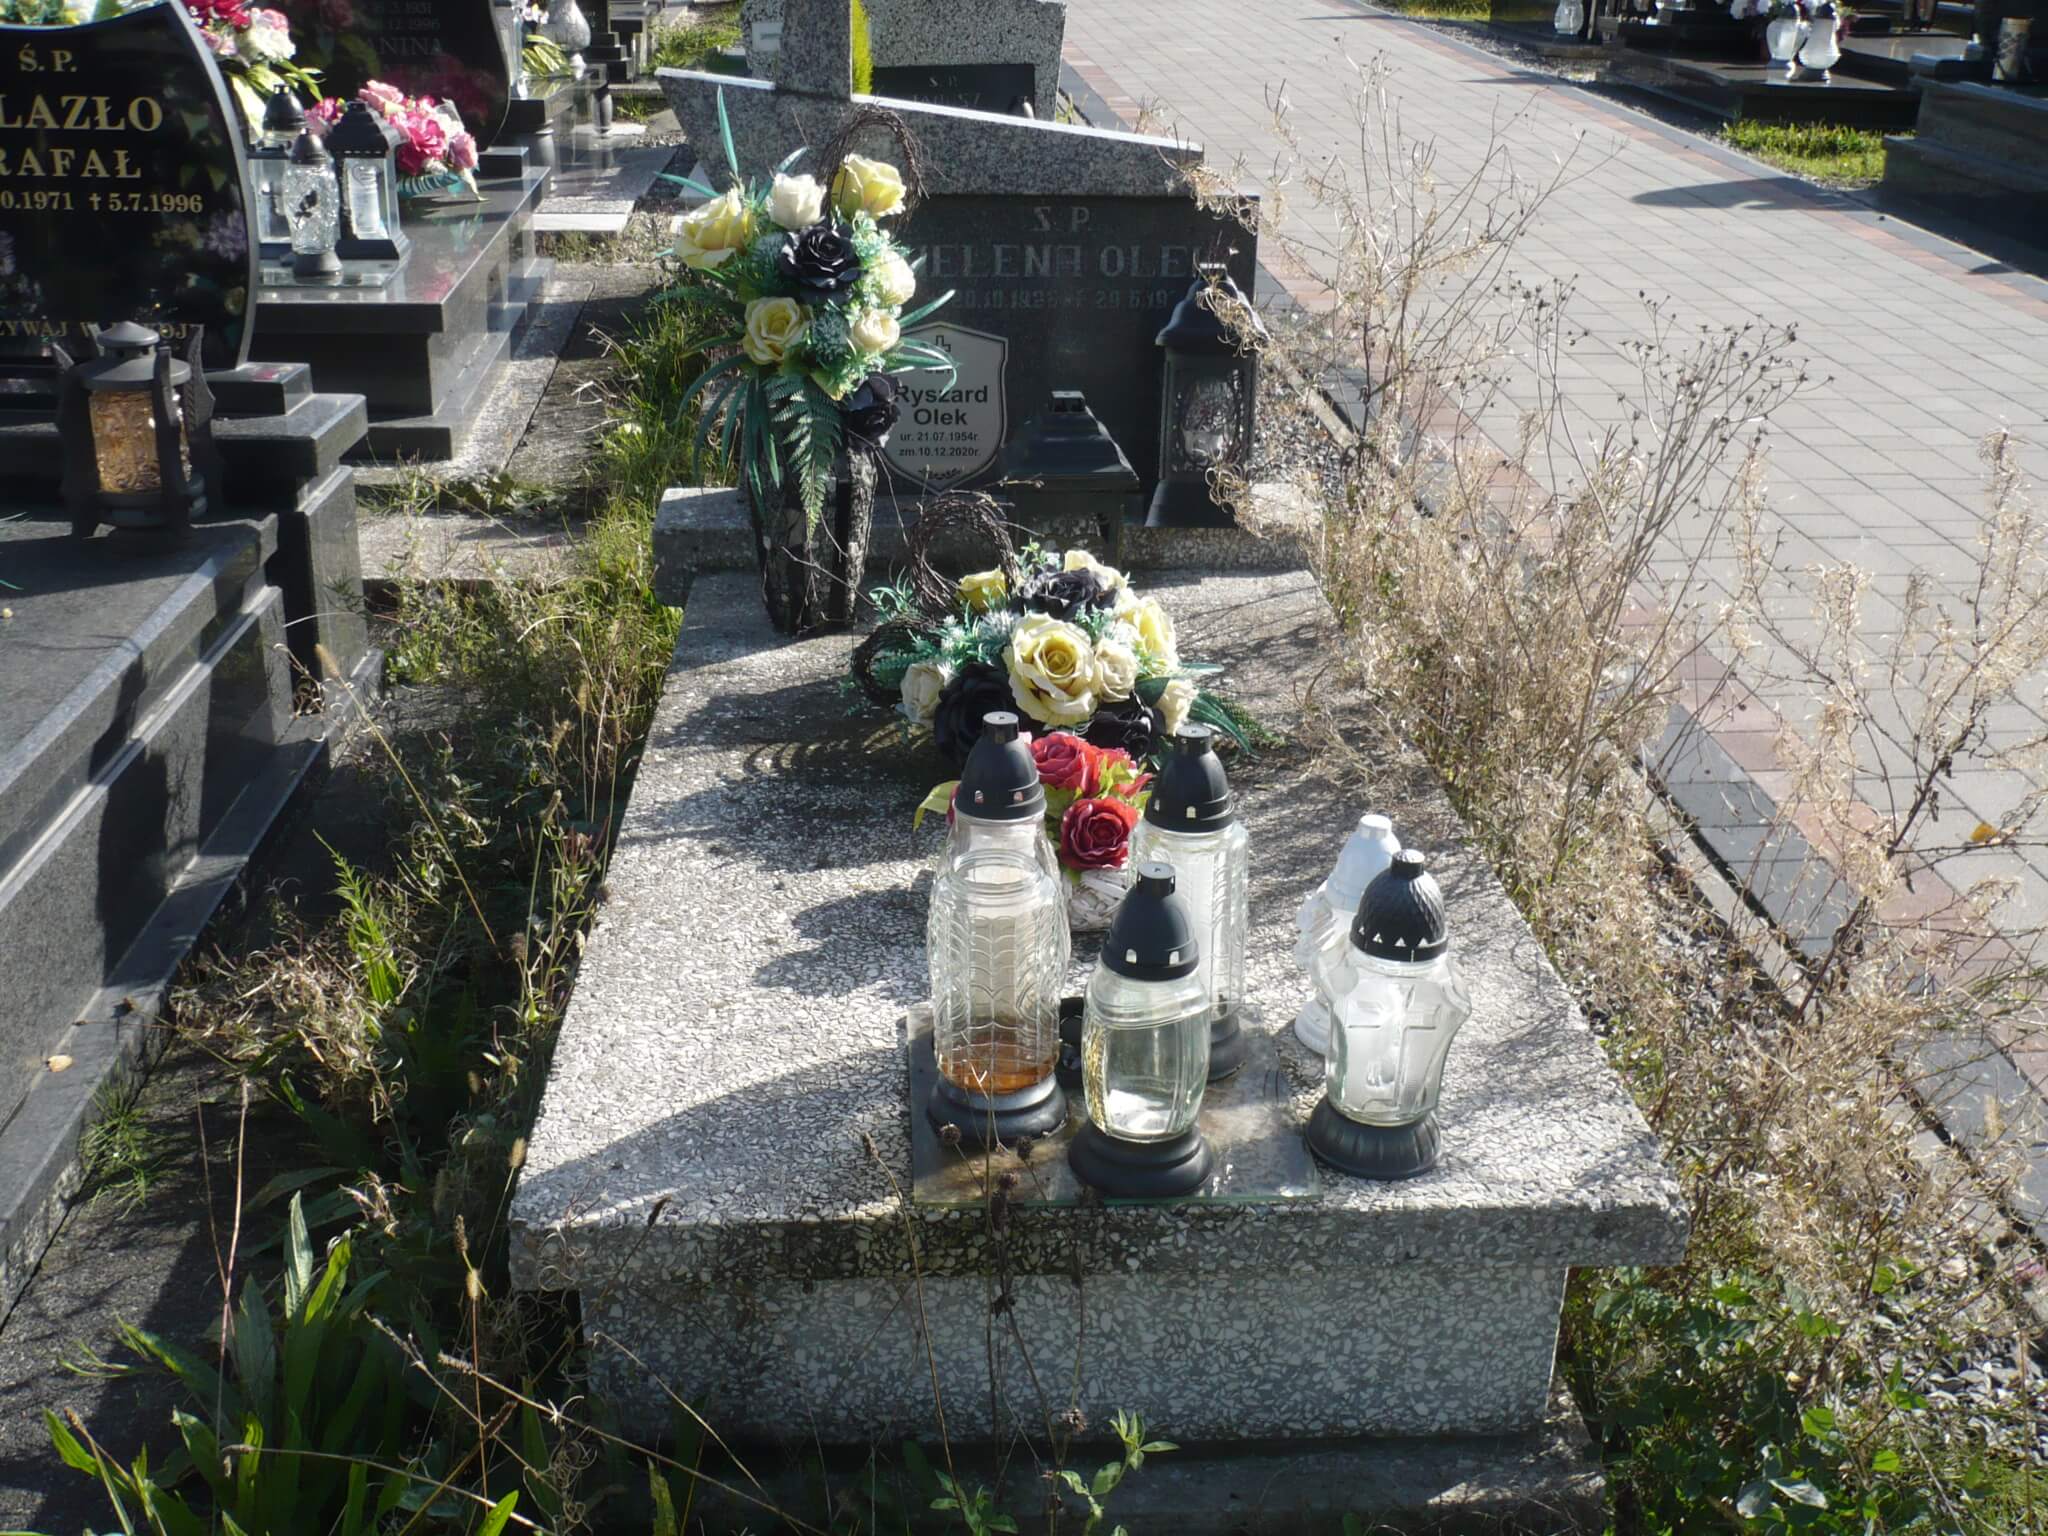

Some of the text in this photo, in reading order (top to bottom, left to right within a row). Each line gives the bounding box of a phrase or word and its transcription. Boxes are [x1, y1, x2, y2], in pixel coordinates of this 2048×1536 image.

[51, 49, 78, 72] P.
[108, 193, 203, 213] 5.7.1996
[896, 385, 988, 407] Ryszard
[913, 408, 968, 425] Olek
[900, 432, 914, 441] ur.
